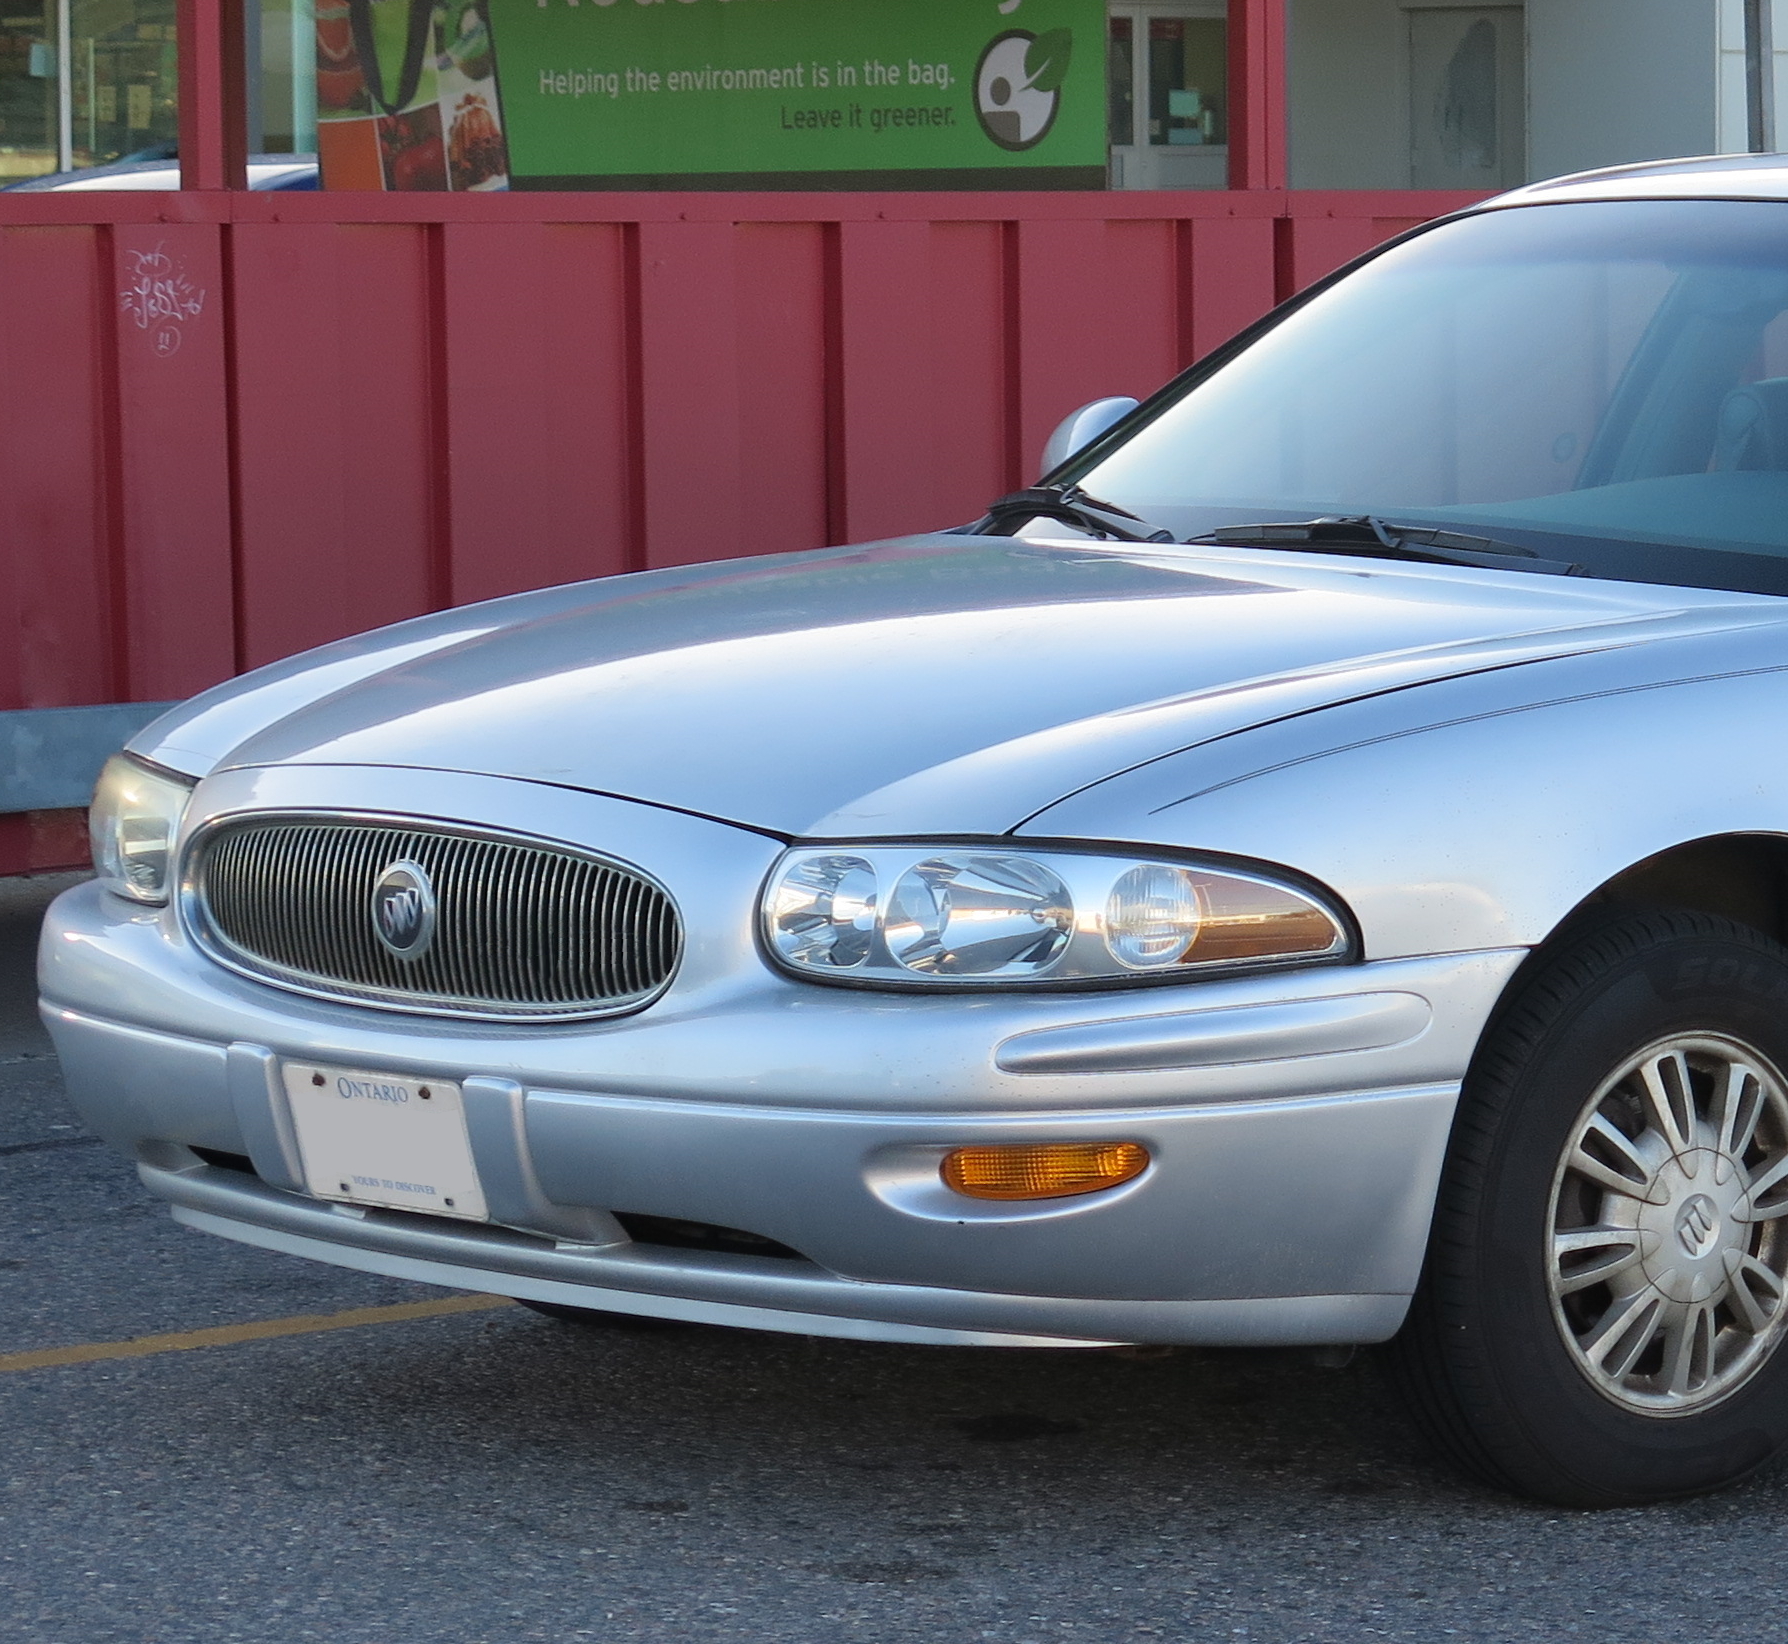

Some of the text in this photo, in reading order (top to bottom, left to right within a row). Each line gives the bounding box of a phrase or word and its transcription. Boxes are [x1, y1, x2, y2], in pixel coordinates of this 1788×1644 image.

[539, 57, 956, 99] Helping the environment is in the bag.
[780, 103, 957, 134] Leave it greener.
[381, 1178, 394, 1189] TO
[395, 1181, 437, 1196] DISCOVER
